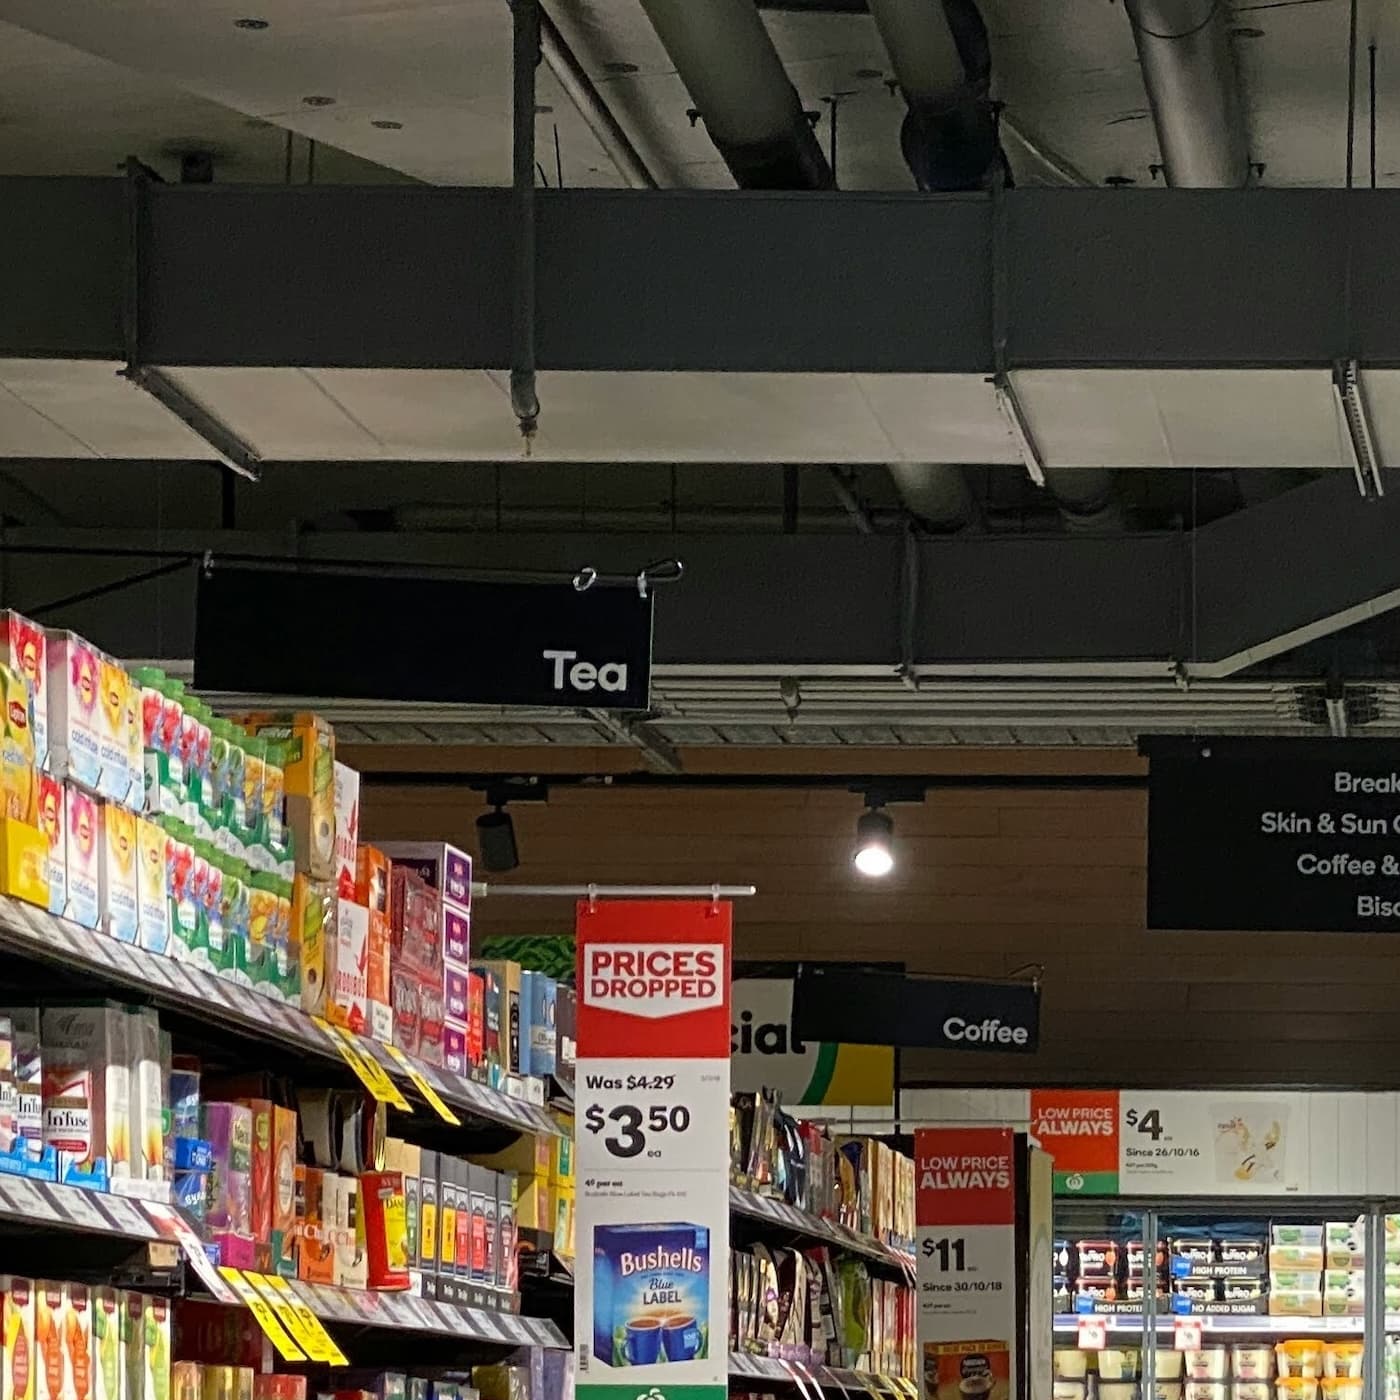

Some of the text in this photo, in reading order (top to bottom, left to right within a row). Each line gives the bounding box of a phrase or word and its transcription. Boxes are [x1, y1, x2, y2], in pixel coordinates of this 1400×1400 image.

[544, 650, 627, 692] Tea
[1260, 812, 1312, 834] Skin
[1318, 813, 1335, 834] &
[1341, 813, 1387, 835] Sun
[1296, 853, 1376, 877] Coffee
[1381, 855, 1400, 876] &
[591, 951, 716, 977] PRICES
[591, 979, 716, 999] DROPPED
[943, 1017, 1029, 1045] Coffee
[586, 1075, 675, 1091] Was $4.29
[1038, 1108, 1112, 1119] LOW PRICE
[1037, 1120, 1113, 1136] ALWAYS
[1126, 1108, 1163, 1141] $4
[647, 1149, 662, 1158] ea
[1126, 1147, 1200, 1158] Since 26/10/16
[921, 1156, 1009, 1171] LOW PRICE
[920, 1171, 1010, 1189] ALWAYS
[620, 1245, 702, 1277] Bushells
[922, 1238, 966, 1272] $11
[1192, 1266, 1211, 1275] HIGH
[1215, 1266, 1247, 1275] PROTEIN
[648, 1277, 674, 1290] Blue
[922, 1281, 1003, 1292] Since 30/10/18
[643, 1291, 682, 1306] LABEL
[1094, 1304, 1115, 1313] HIGH
[1117, 1304, 1143, 1313] PROTEI
[1191, 1304, 1204, 1313] NO
[1206, 1304, 1230, 1313] ADDED
[1232, 1304, 1256, 1313] SUGAR
